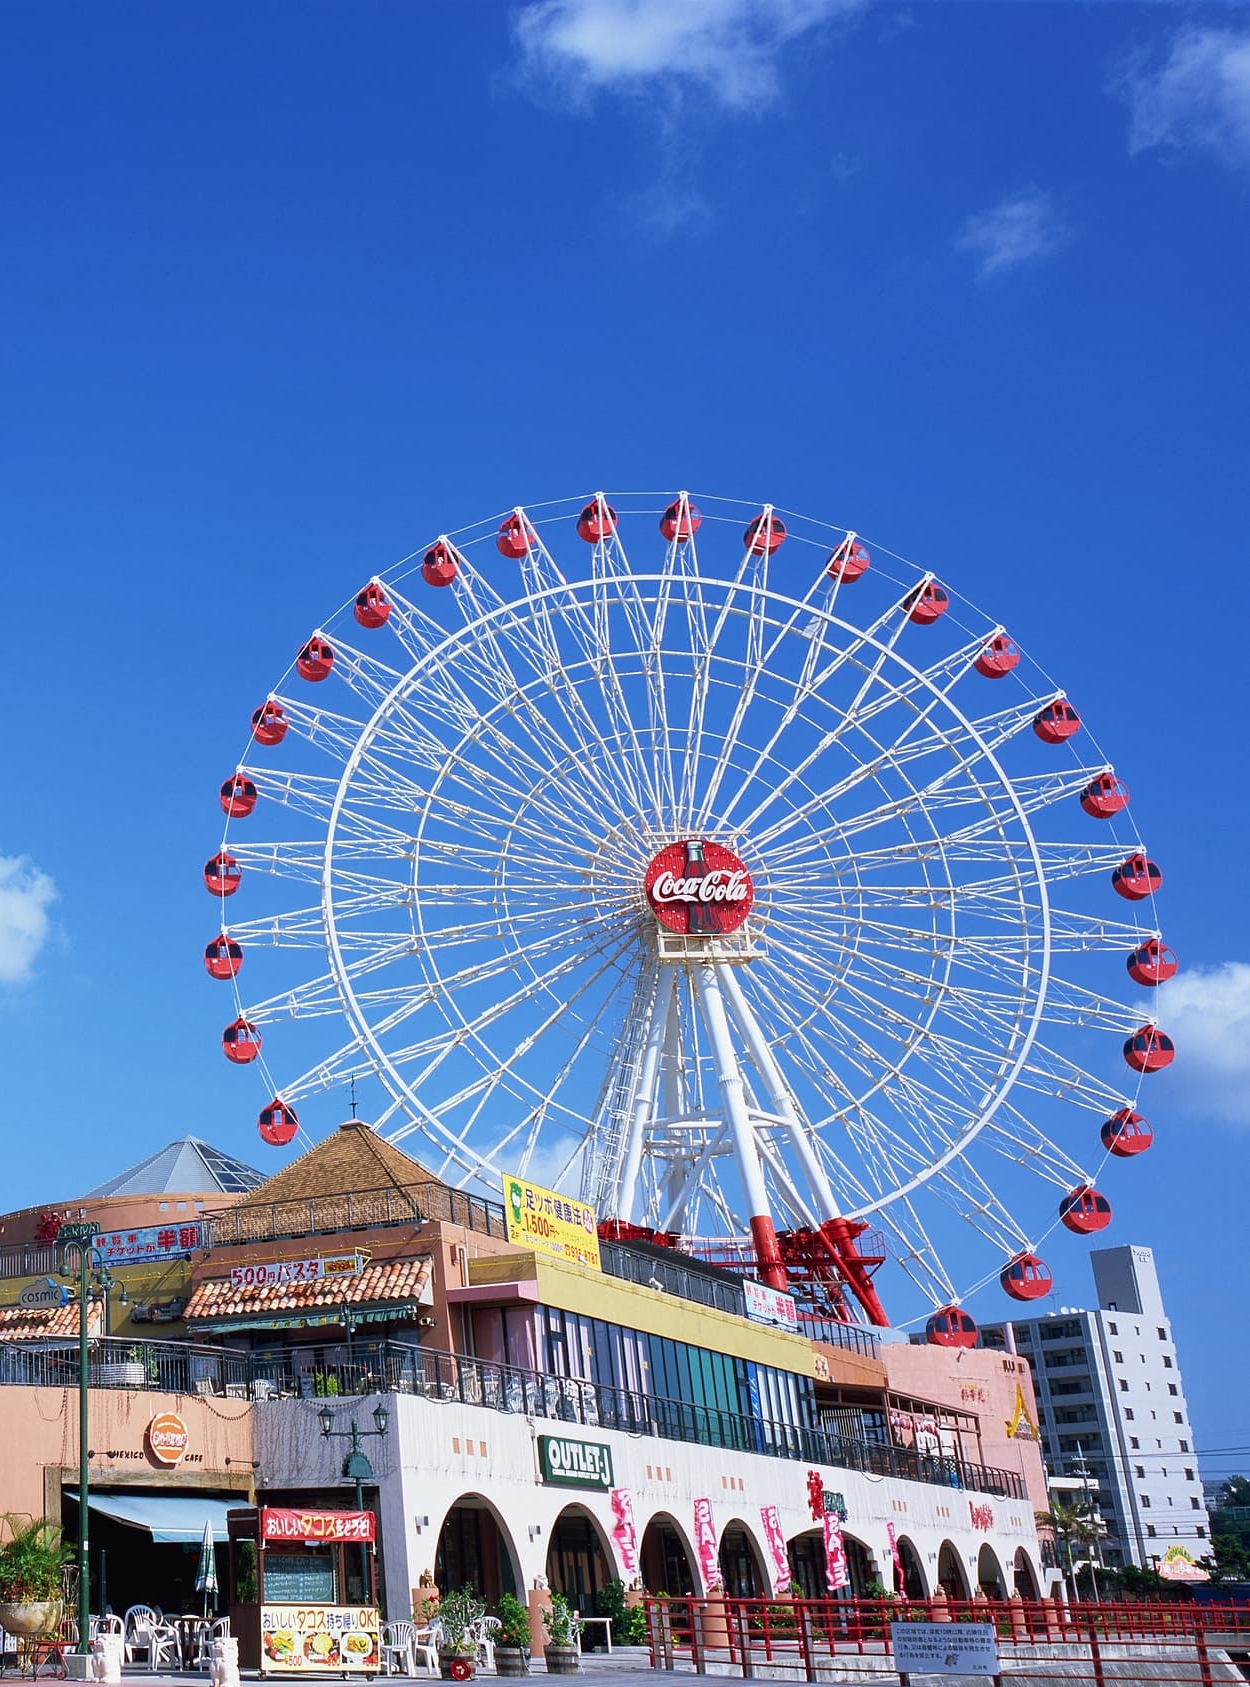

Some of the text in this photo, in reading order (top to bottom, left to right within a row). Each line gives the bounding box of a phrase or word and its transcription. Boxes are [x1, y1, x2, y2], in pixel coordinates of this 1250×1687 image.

[652, 869, 749, 903] Coca-Cola
[106, 1244, 157, 1257] チケットが
[157, 1226, 199, 1251] 半額
[232, 1261, 319, 1286] 500円パスタ
[548, 1439, 610, 1485] OUTLET-J
[699, 1500, 721, 1584] SALE
[827, 1514, 848, 1585] SALE
